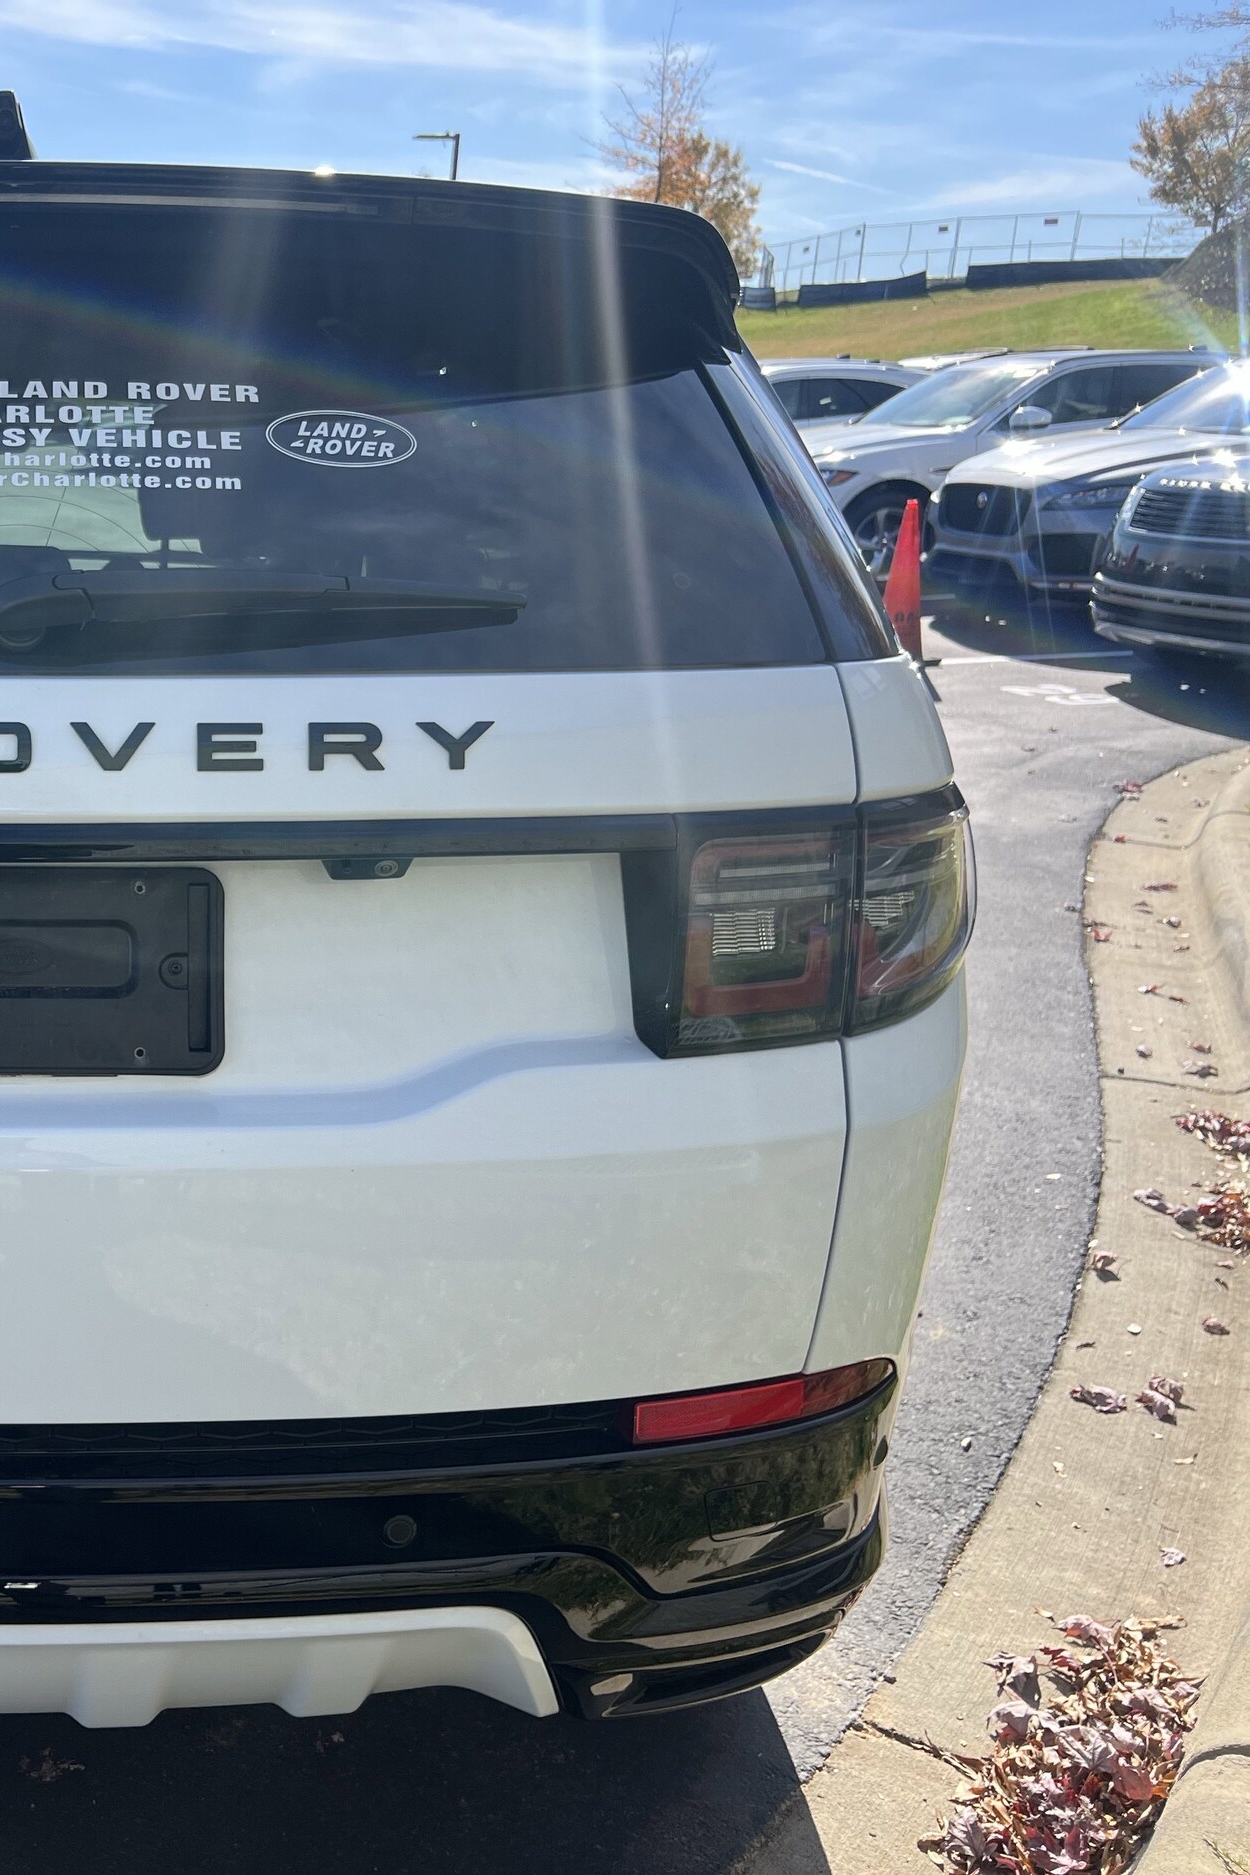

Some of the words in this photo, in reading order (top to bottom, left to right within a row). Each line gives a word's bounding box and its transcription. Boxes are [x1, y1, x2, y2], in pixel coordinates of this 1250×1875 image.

[0, 381, 108, 399] LAND
[127, 382, 260, 402] ROVER
[297, 420, 367, 438] LAND
[68, 429, 242, 450] VEHICLE
[305, 438, 395, 458] ROVER
